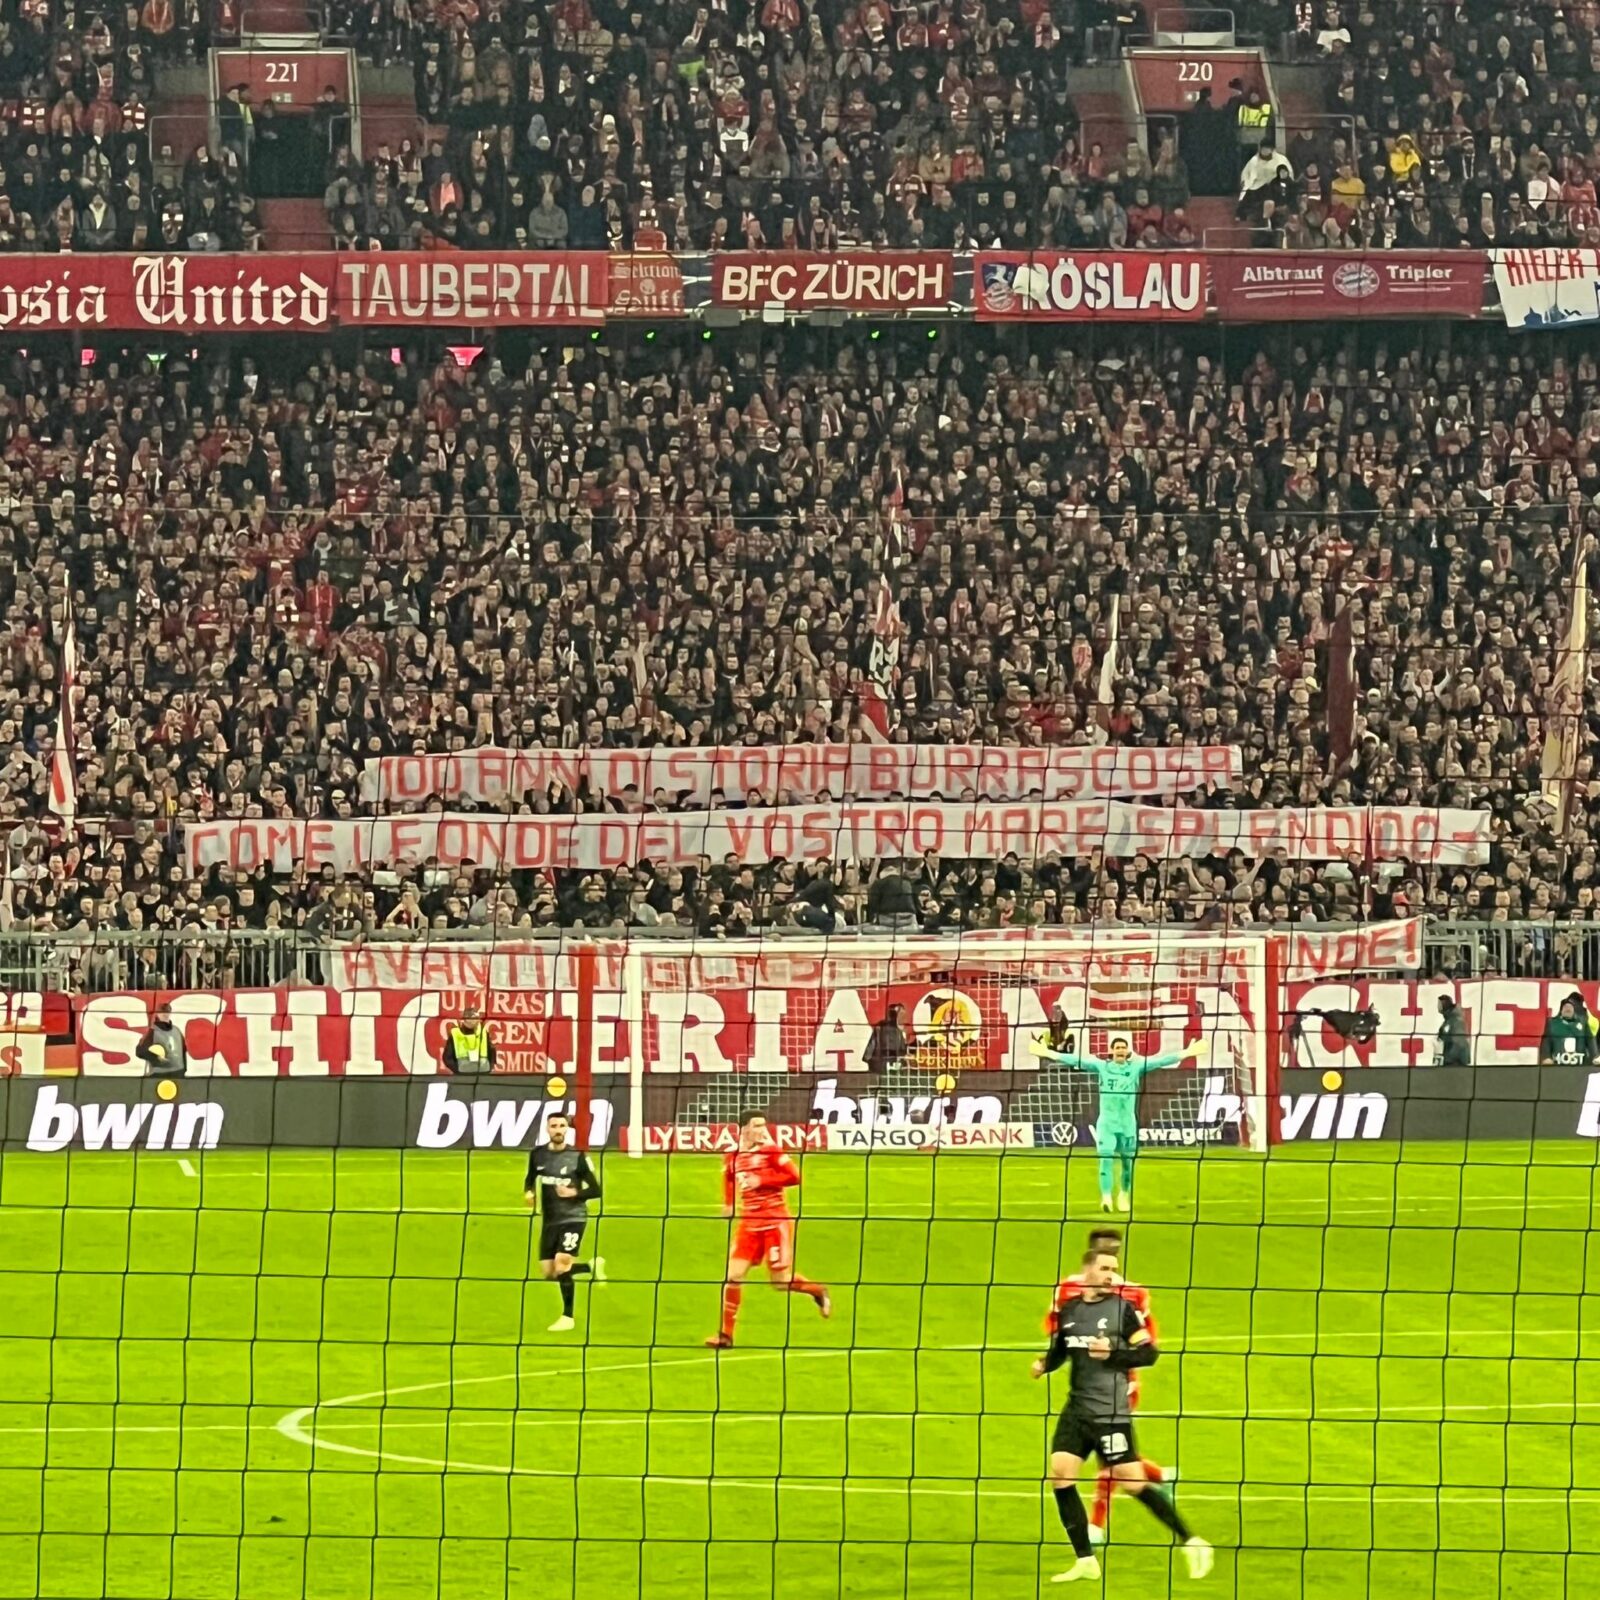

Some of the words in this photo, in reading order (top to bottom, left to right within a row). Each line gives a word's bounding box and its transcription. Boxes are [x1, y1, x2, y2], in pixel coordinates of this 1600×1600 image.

[264, 62, 298, 82] 221
[1178, 62, 1213, 81] 220
[722, 265, 797, 300] BFC
[803, 260, 943, 300] ZÜRICH
[1242, 265, 1323, 282] Albtrauf
[1385, 264, 1453, 282] Tripler
[133, 256, 328, 325] United
[342, 263, 604, 318] TAUBERTAL
[381, 756, 462, 796] 100
[669, 746, 850, 793] STORIA
[870, 746, 1231, 792] BURRASCOSA
[192, 824, 335, 872] COME
[600, 819, 699, 865] DEL
[725, 808, 943, 860] VOSTRO
[964, 806, 1105, 854] MARE
[441, 991, 545, 1014] ULTRAS
[440, 1019, 545, 1045] GEN
[26, 1083, 224, 1151] bwin
[645, 1125, 821, 1151] LYERAARM
[837, 1129, 926, 1146] TARGO
[951, 1129, 1023, 1145] BANK
[1088, 1124, 1222, 1145] swagen
